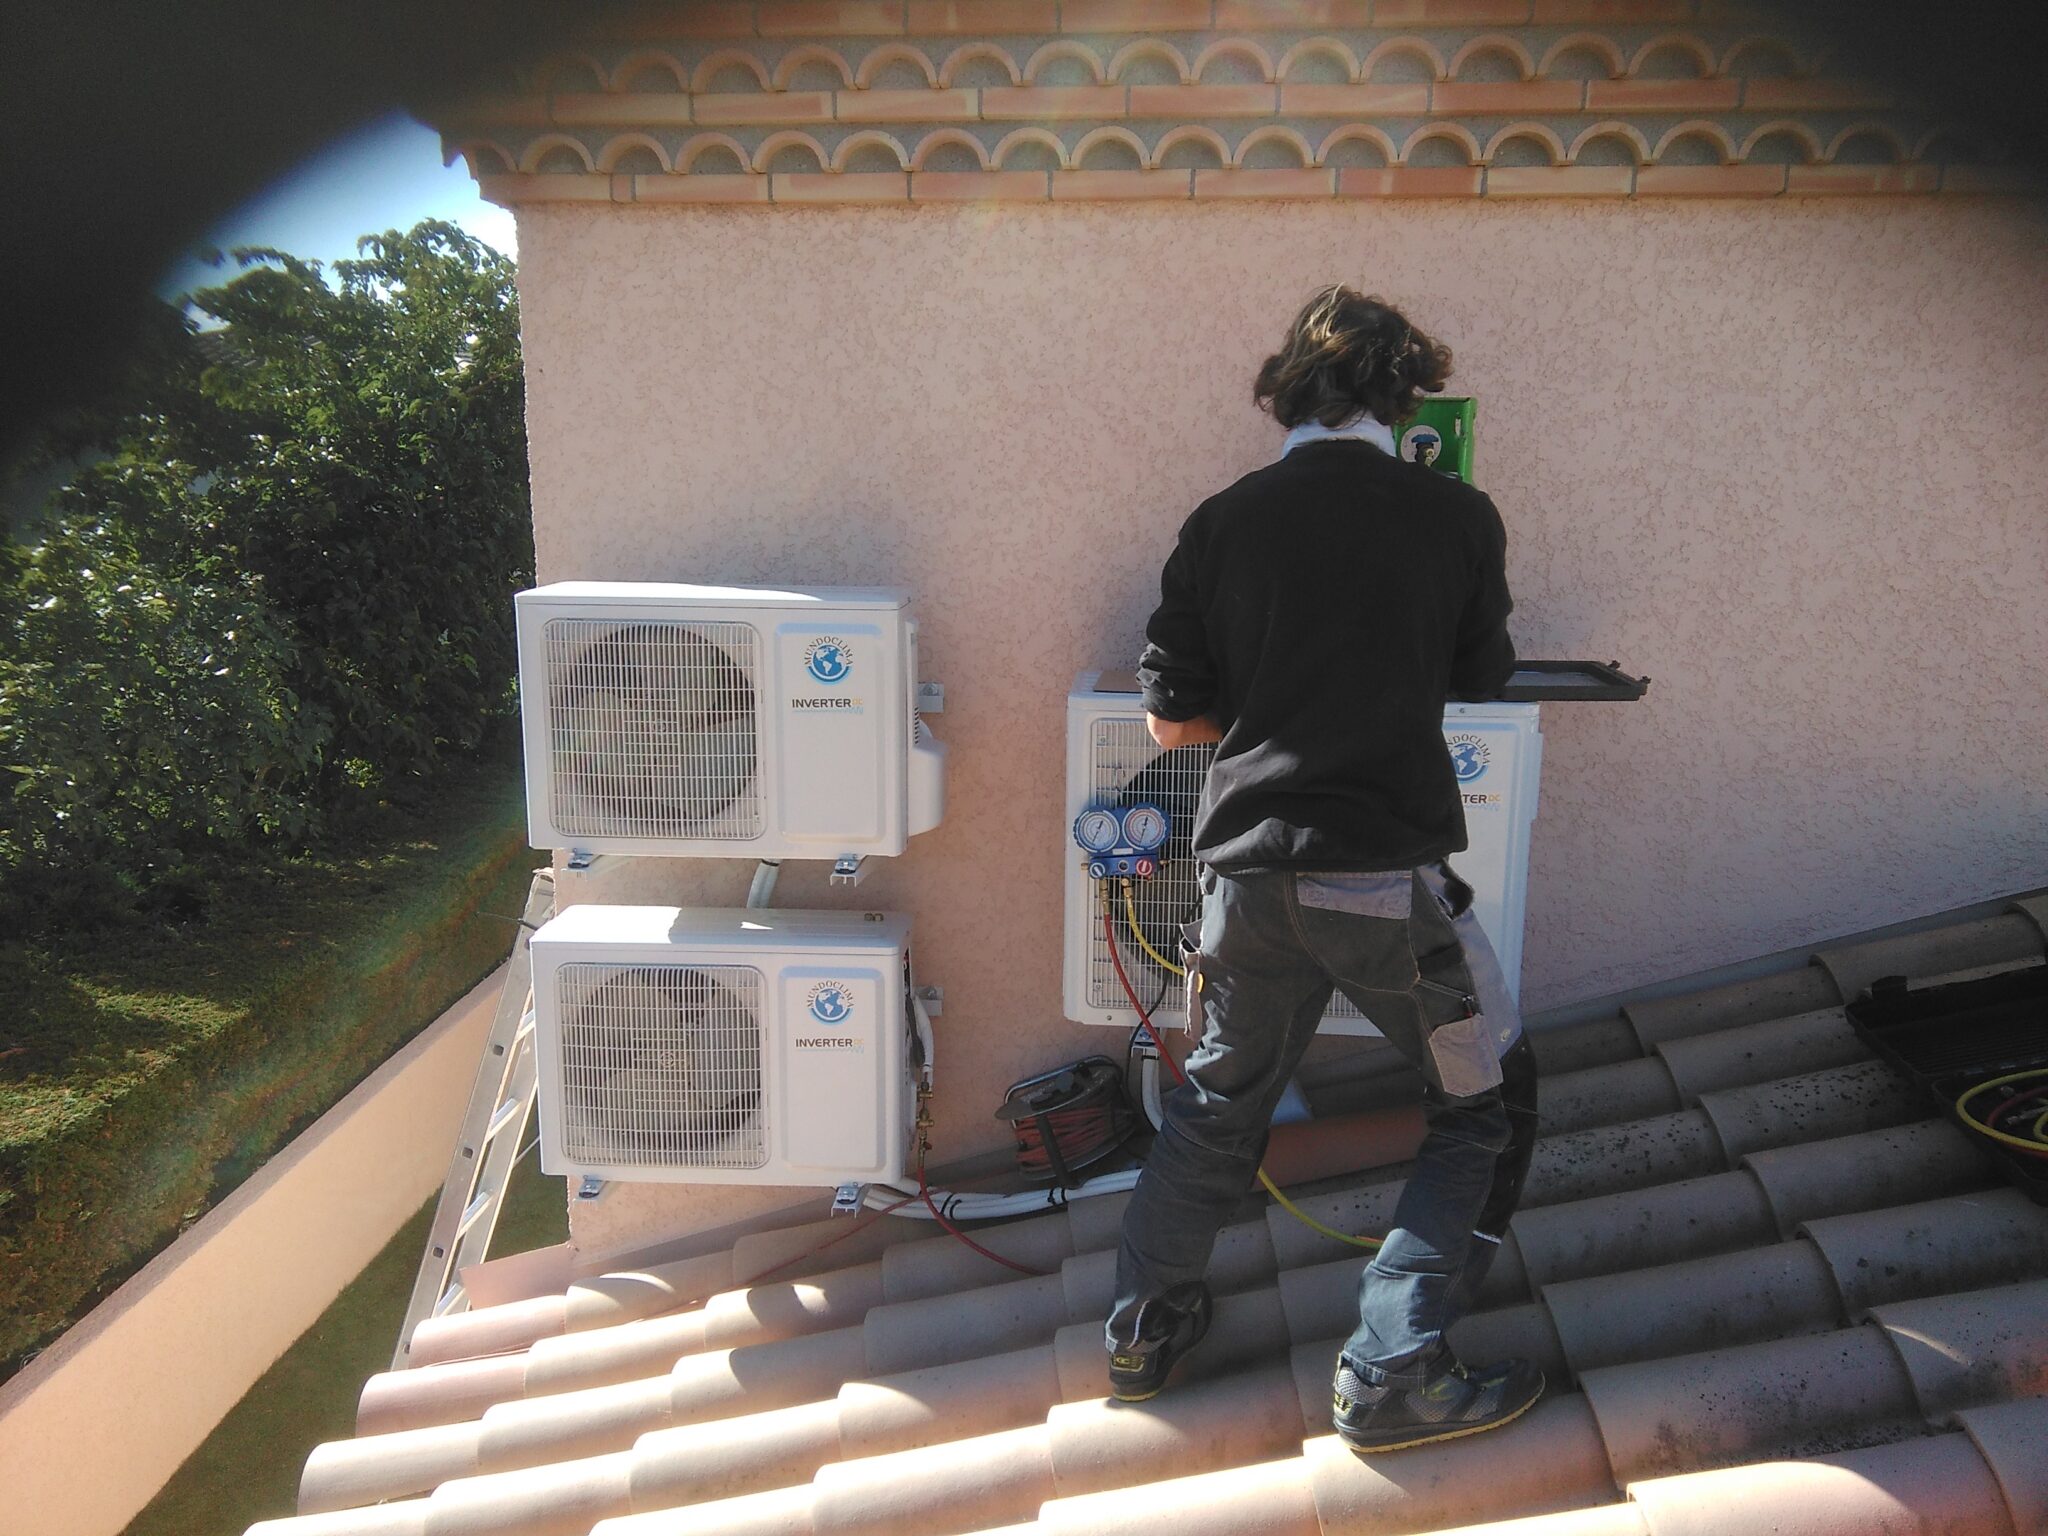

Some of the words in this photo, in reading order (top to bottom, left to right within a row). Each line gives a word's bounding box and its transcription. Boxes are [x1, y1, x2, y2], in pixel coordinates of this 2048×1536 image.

[804, 636, 853, 665] MUNDOCLIMA
[792, 698, 851, 708] INVERTER
[1446, 733, 1491, 764] NDOCLIMA
[1462, 794, 1487, 804] TER
[1488, 794, 1501, 802] DC
[807, 980, 854, 1008] MUNDOCLIMA
[796, 1038, 853, 1047] INVERTER
